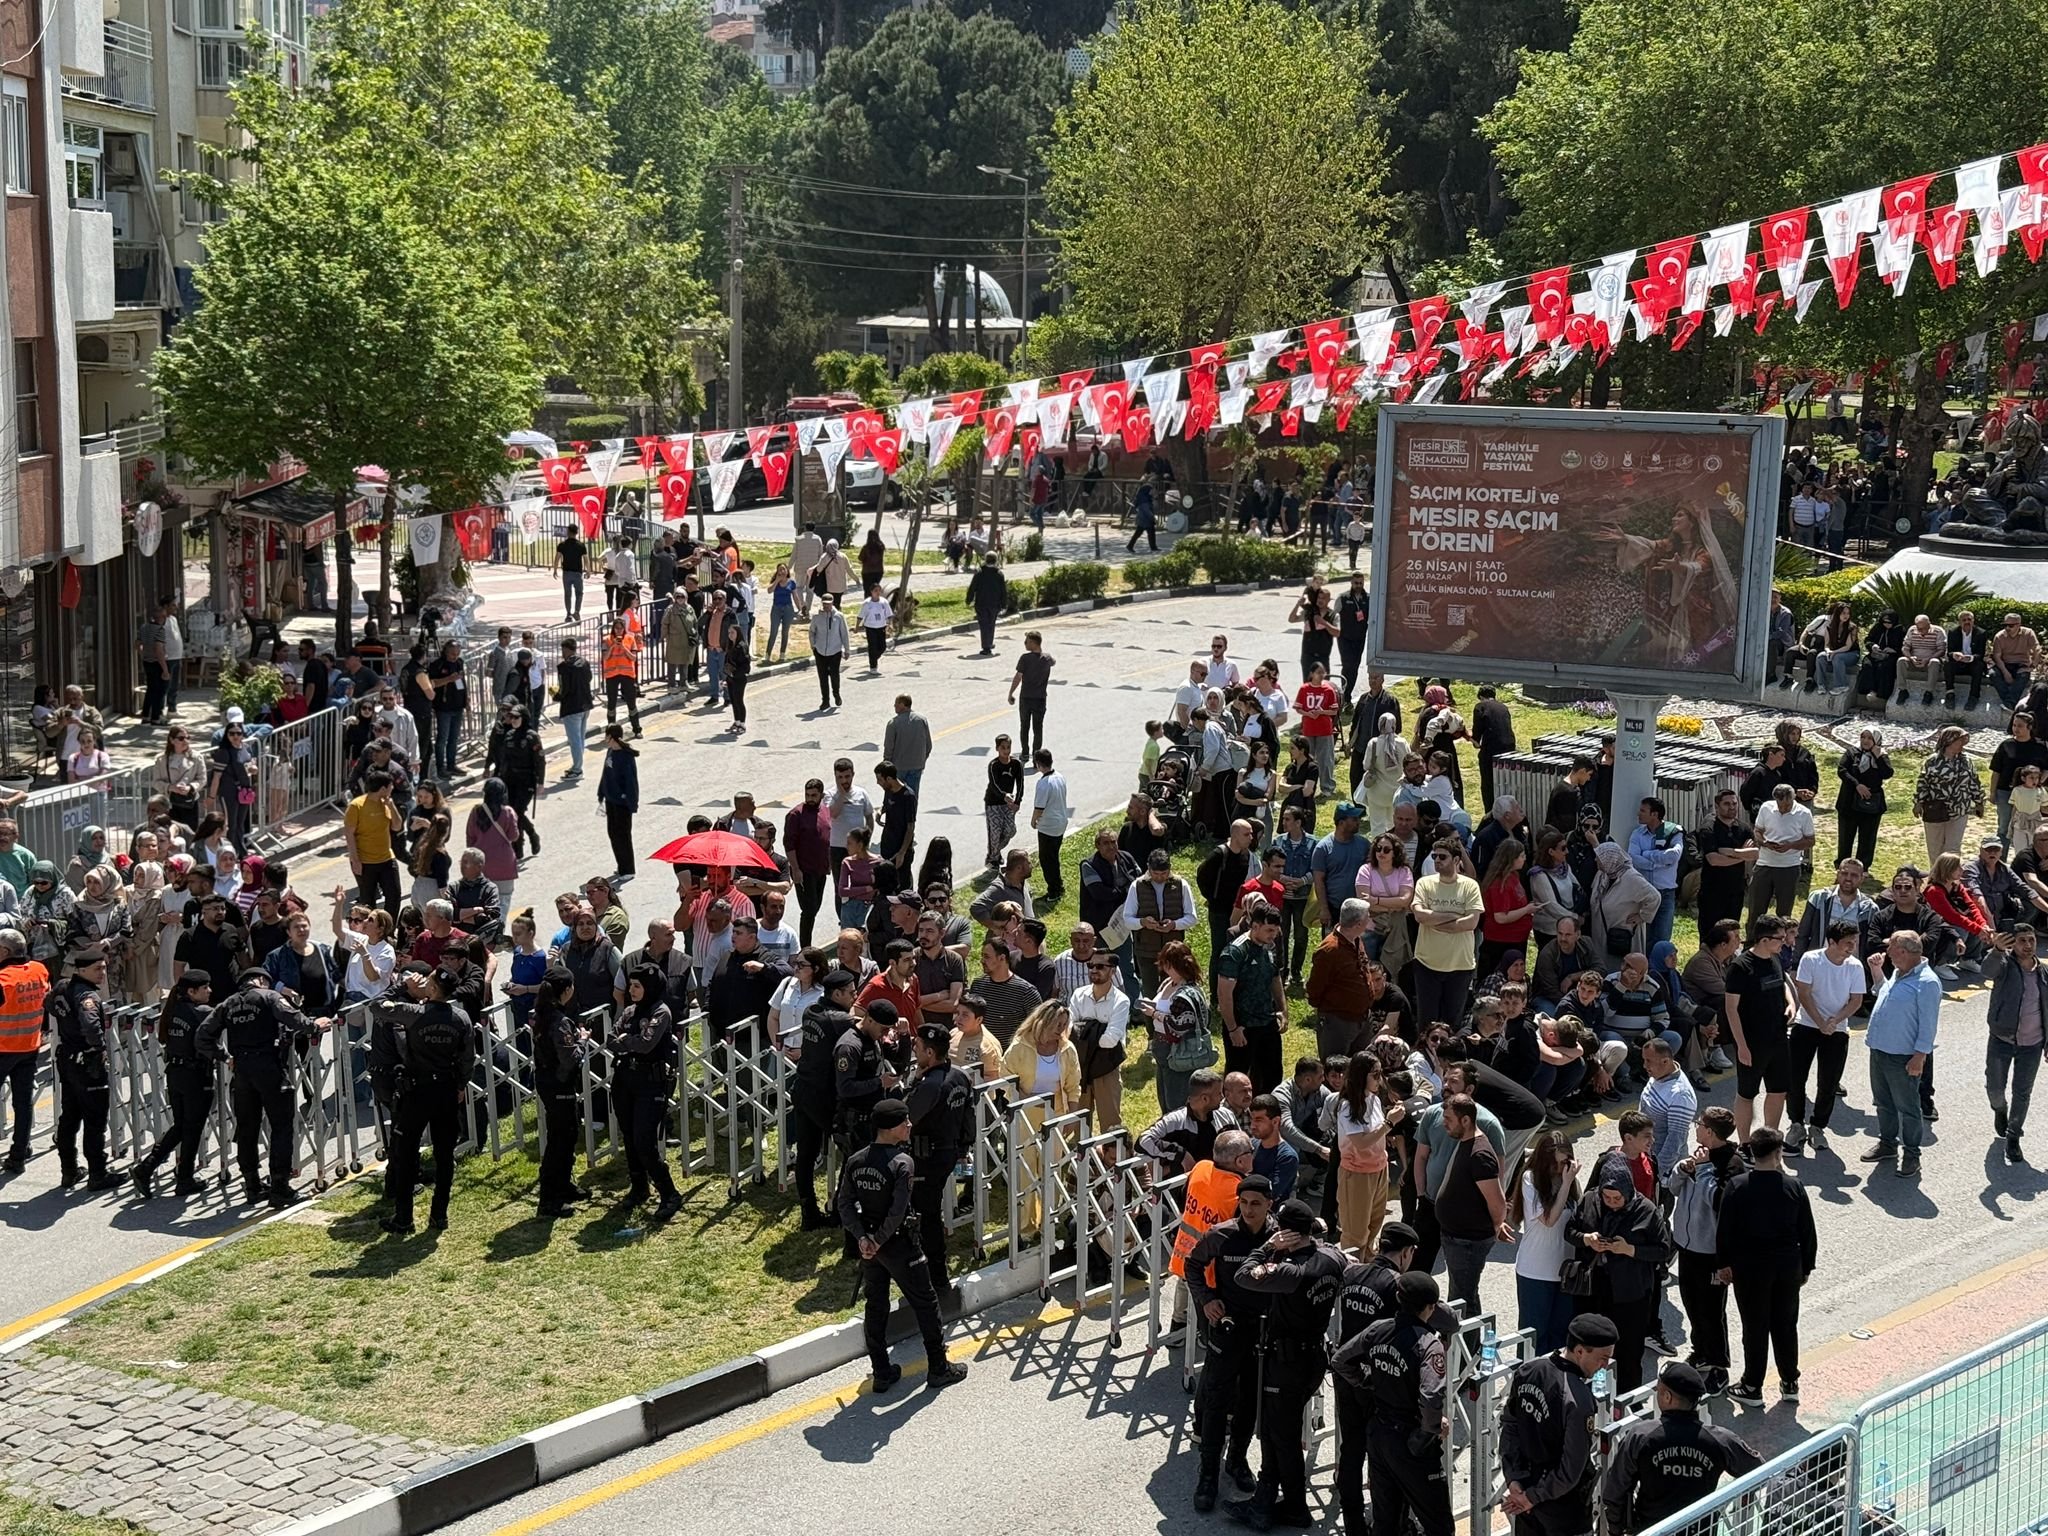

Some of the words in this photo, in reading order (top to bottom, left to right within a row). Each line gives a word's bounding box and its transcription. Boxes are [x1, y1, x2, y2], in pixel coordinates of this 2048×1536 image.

[1413, 441, 1441, 451] MESİR
[1483, 441, 1539, 453] TARİHİYLE
[1425, 455, 1467, 465] MACUNU
[1483, 452, 1533, 462] YAŞAYAN
[1482, 461, 1534, 472] FESTİVAL
[1409, 485, 1461, 503] SAÇIM
[1465, 486, 1536, 504] KORTEJİ
[1540, 492, 1560, 505] ve
[1409, 504, 1480, 528] MESİR
[1484, 509, 1558, 534] SAÇIM
[1408, 526, 1494, 553] TÖRENİ
[1406, 559, 1422, 571] 26
[1426, 558, 1467, 573] NİSAN
[1475, 560, 1505, 570] SAAT:
[1405, 572, 1425, 580] 2026
[1426, 573, 1452, 581] PAZAR
[1475, 571, 1508, 583] 11.00
[1405, 584, 1437, 593] VALİLİK
[1438, 585, 1466, 595] BİNASI
[1468, 586, 1488, 596] ÖNÜ
[1496, 588, 1529, 598] SULTAN
[1531, 589, 1555, 599] CAMİİ
[1306, 695, 1325, 709] 07
[1680, 1446, 1715, 1472] KUVVET
